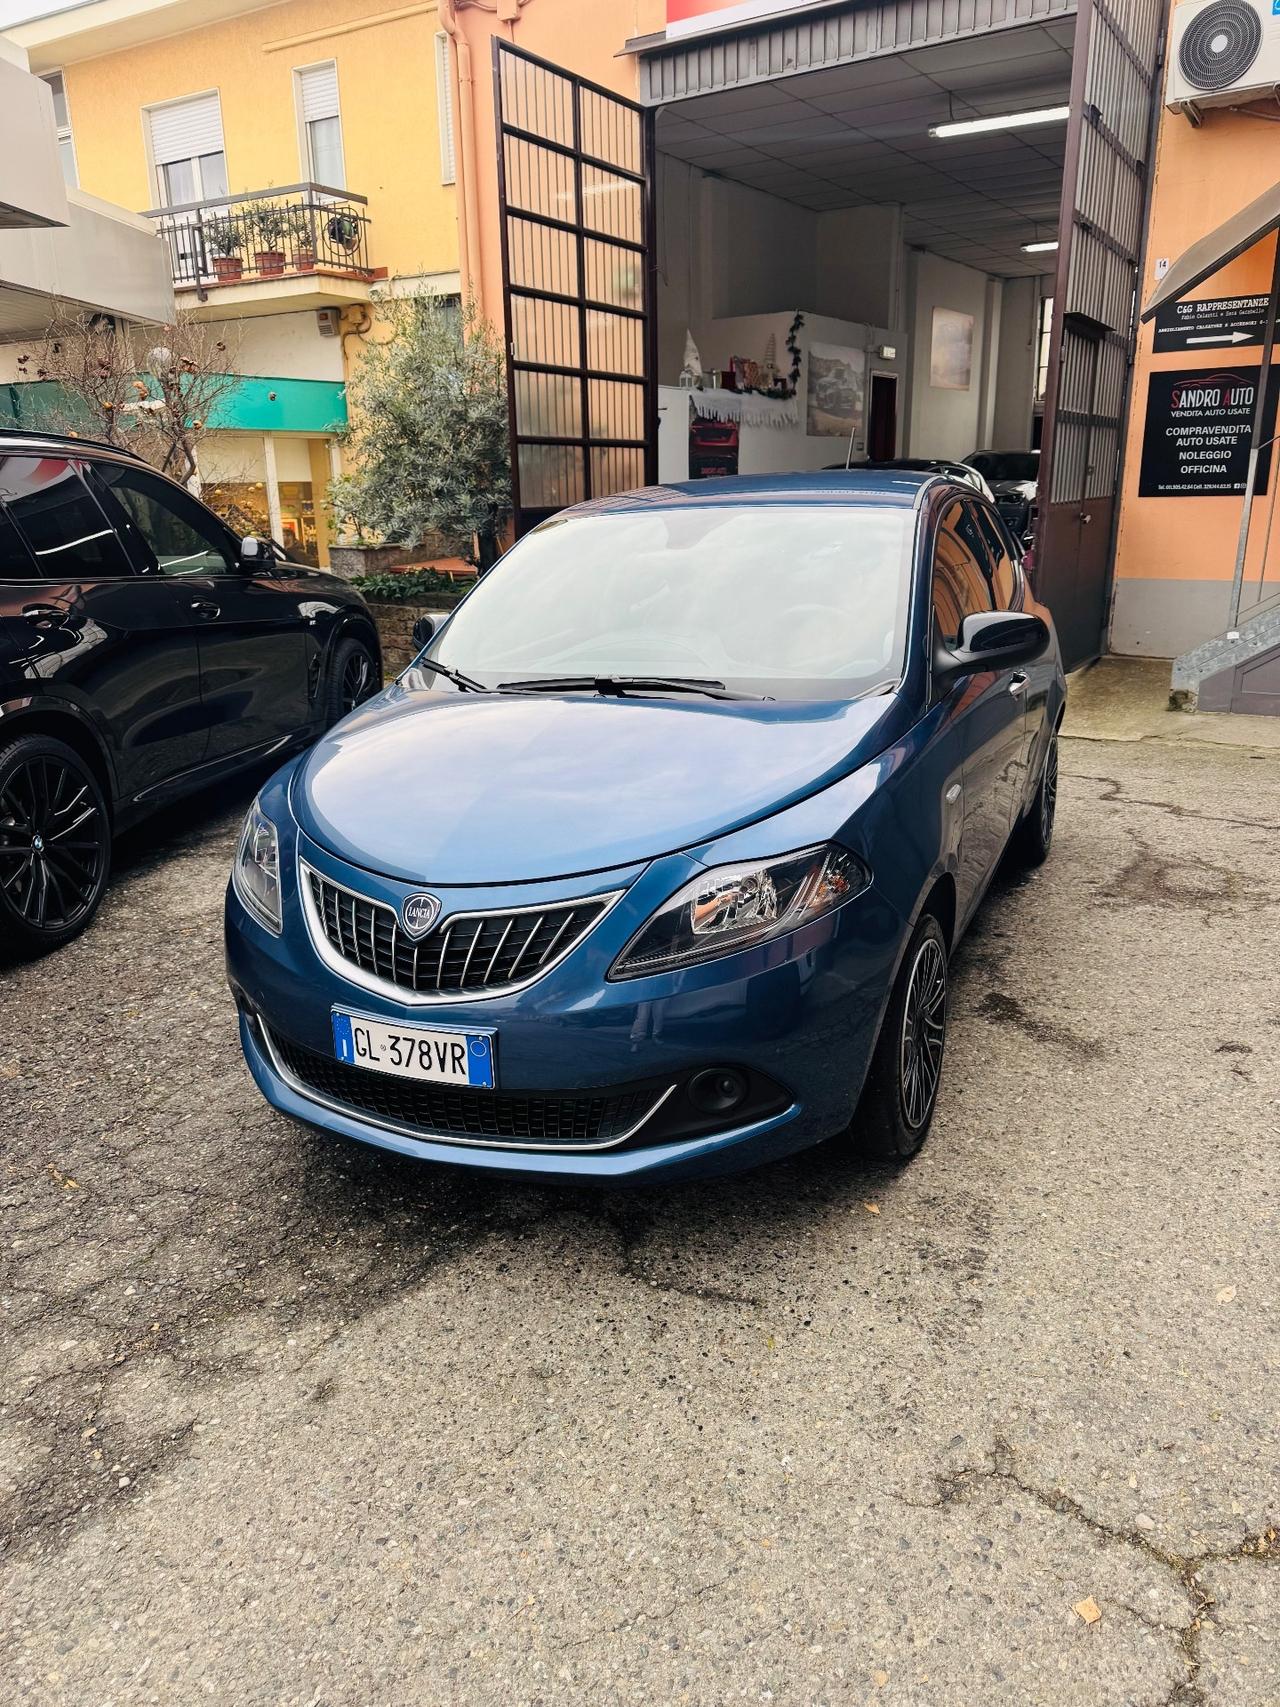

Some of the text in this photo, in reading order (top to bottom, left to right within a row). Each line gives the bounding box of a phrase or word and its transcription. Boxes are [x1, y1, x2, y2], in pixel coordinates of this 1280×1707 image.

[1176, 297, 1270, 314] C&G RAPPRESENTANZE
[1171, 386, 1254, 409] SANDRO AUTO
[1170, 407, 1251, 418] VENDITA AUTO USATE
[1165, 424, 1252, 436] COMPRAVENDITA
[1176, 436, 1238, 447] AUTO USATE
[1178, 450, 1232, 460] NOLEGGIO
[1180, 464, 1227, 474] OFFICINA
[407, 906, 430, 919] LANCIA
[353, 1027, 380, 1062] GL
[387, 1034, 467, 1075] 378VR
